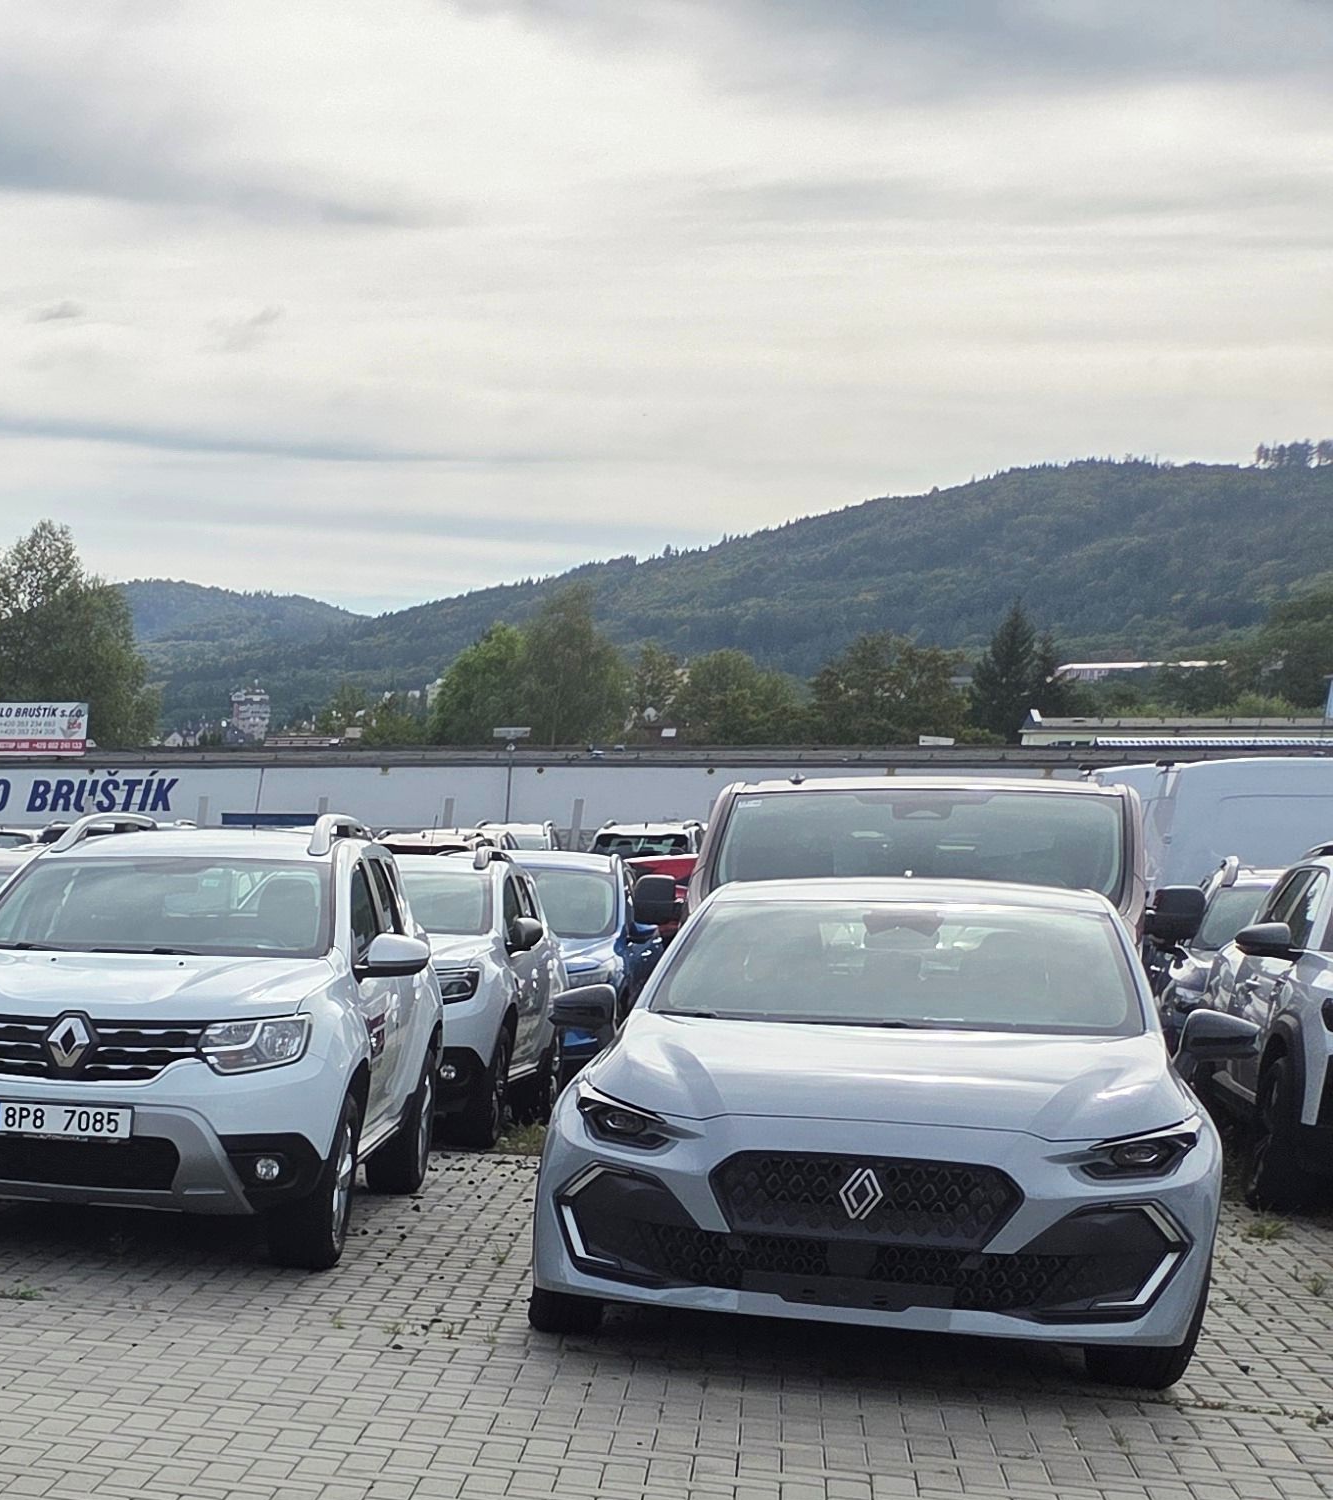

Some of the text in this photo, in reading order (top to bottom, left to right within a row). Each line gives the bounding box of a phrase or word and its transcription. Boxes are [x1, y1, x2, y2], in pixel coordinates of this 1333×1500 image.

[14, 705, 58, 718] BRUŠTÍK
[26, 769, 180, 813] BRUŠTÍK
[4, 1106, 120, 1134] 8P8 7085
